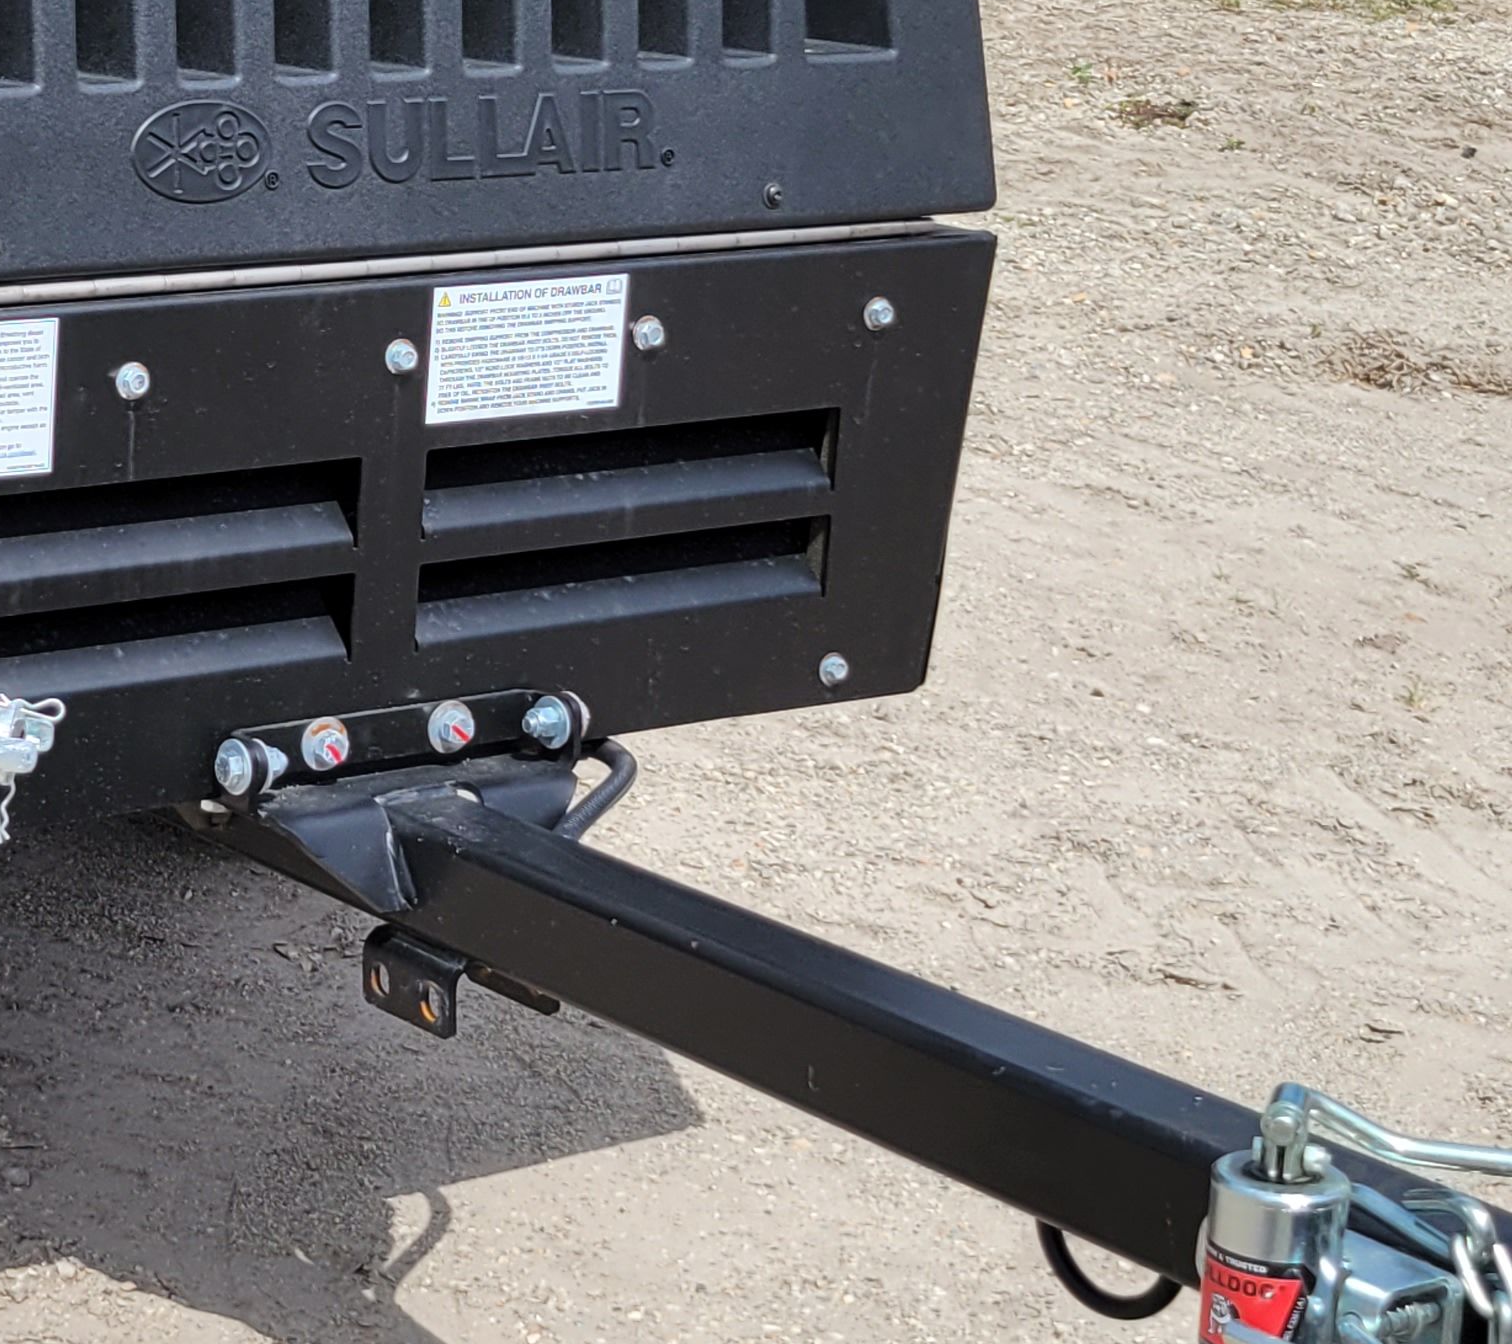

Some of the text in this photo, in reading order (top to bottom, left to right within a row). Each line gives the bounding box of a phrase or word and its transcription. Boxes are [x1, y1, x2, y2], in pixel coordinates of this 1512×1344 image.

[306, 89, 656, 189] SULLAIR
[459, 283, 603, 305] INSTALLATION OF DRAWBAR
